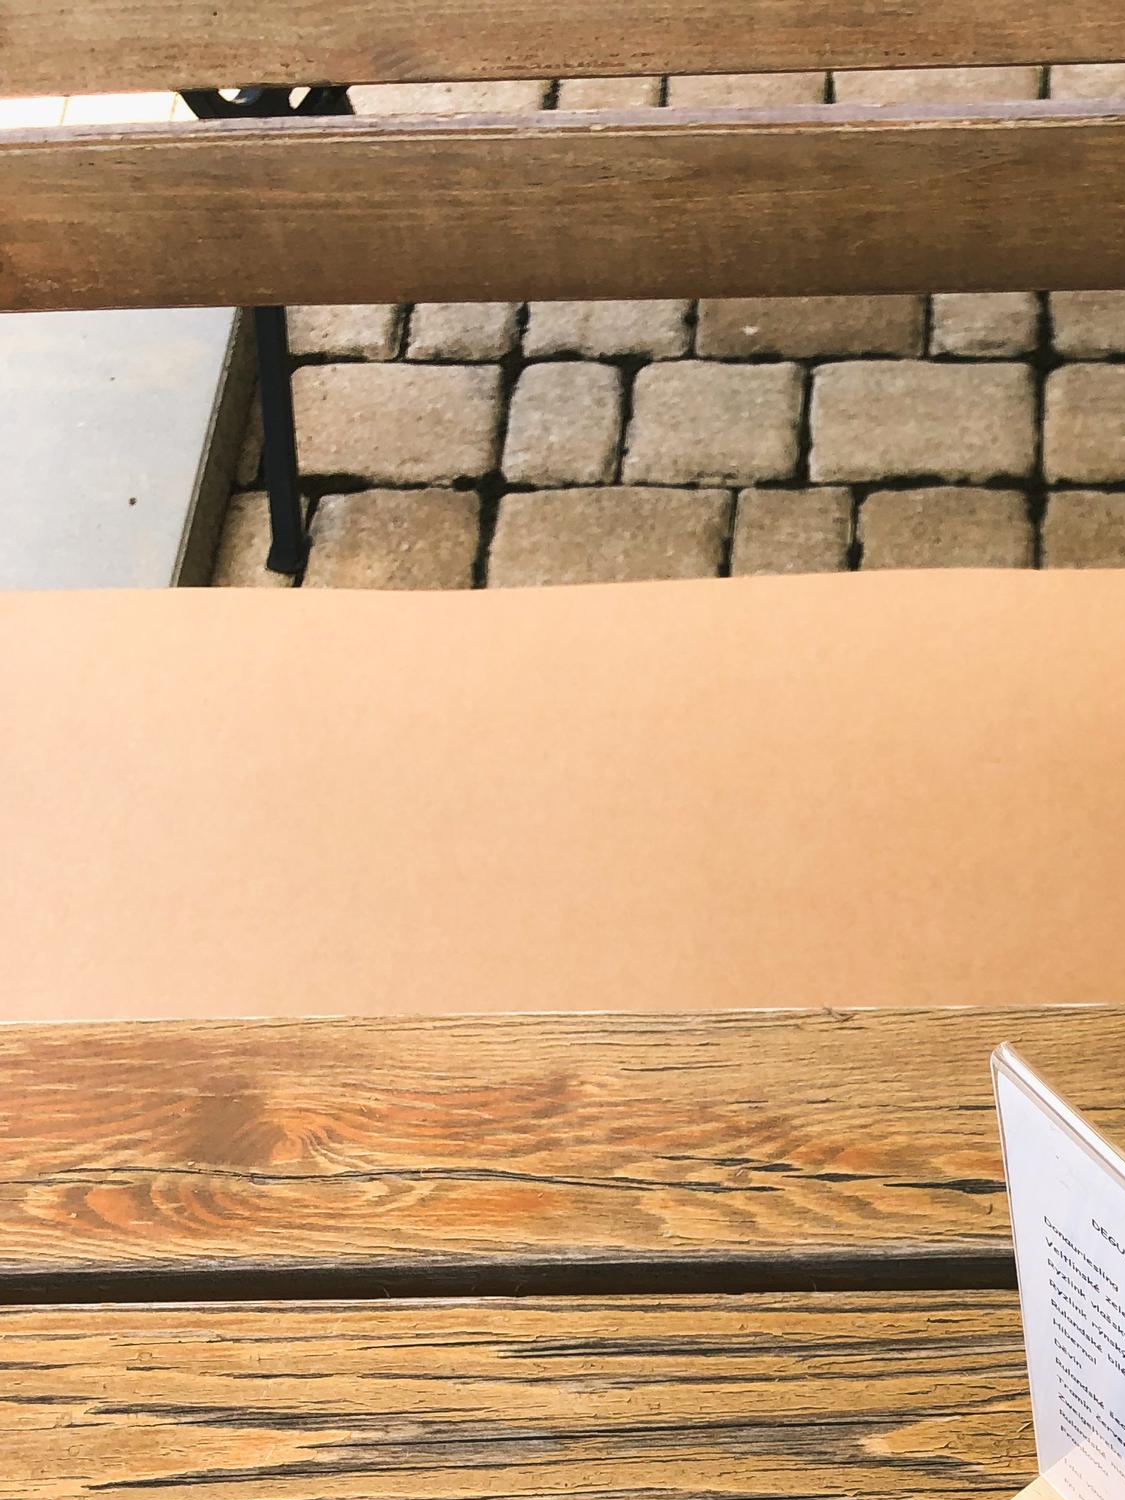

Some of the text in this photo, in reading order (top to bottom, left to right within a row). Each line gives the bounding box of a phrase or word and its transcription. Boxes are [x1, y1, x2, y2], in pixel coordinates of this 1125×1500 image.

[1044, 1216, 1118, 1292] Donauriesling
[1046, 1237, 1099, 1293] Veltlínské
[1048, 1258, 1086, 1300] Ryzlink
[1049, 1279, 1086, 1319] Ryzlink
[1051, 1299, 1102, 1352] Rulandské
[1053, 1318, 1096, 1365] Hibernal
[1056, 1357, 1104, 1409] Rulandské
